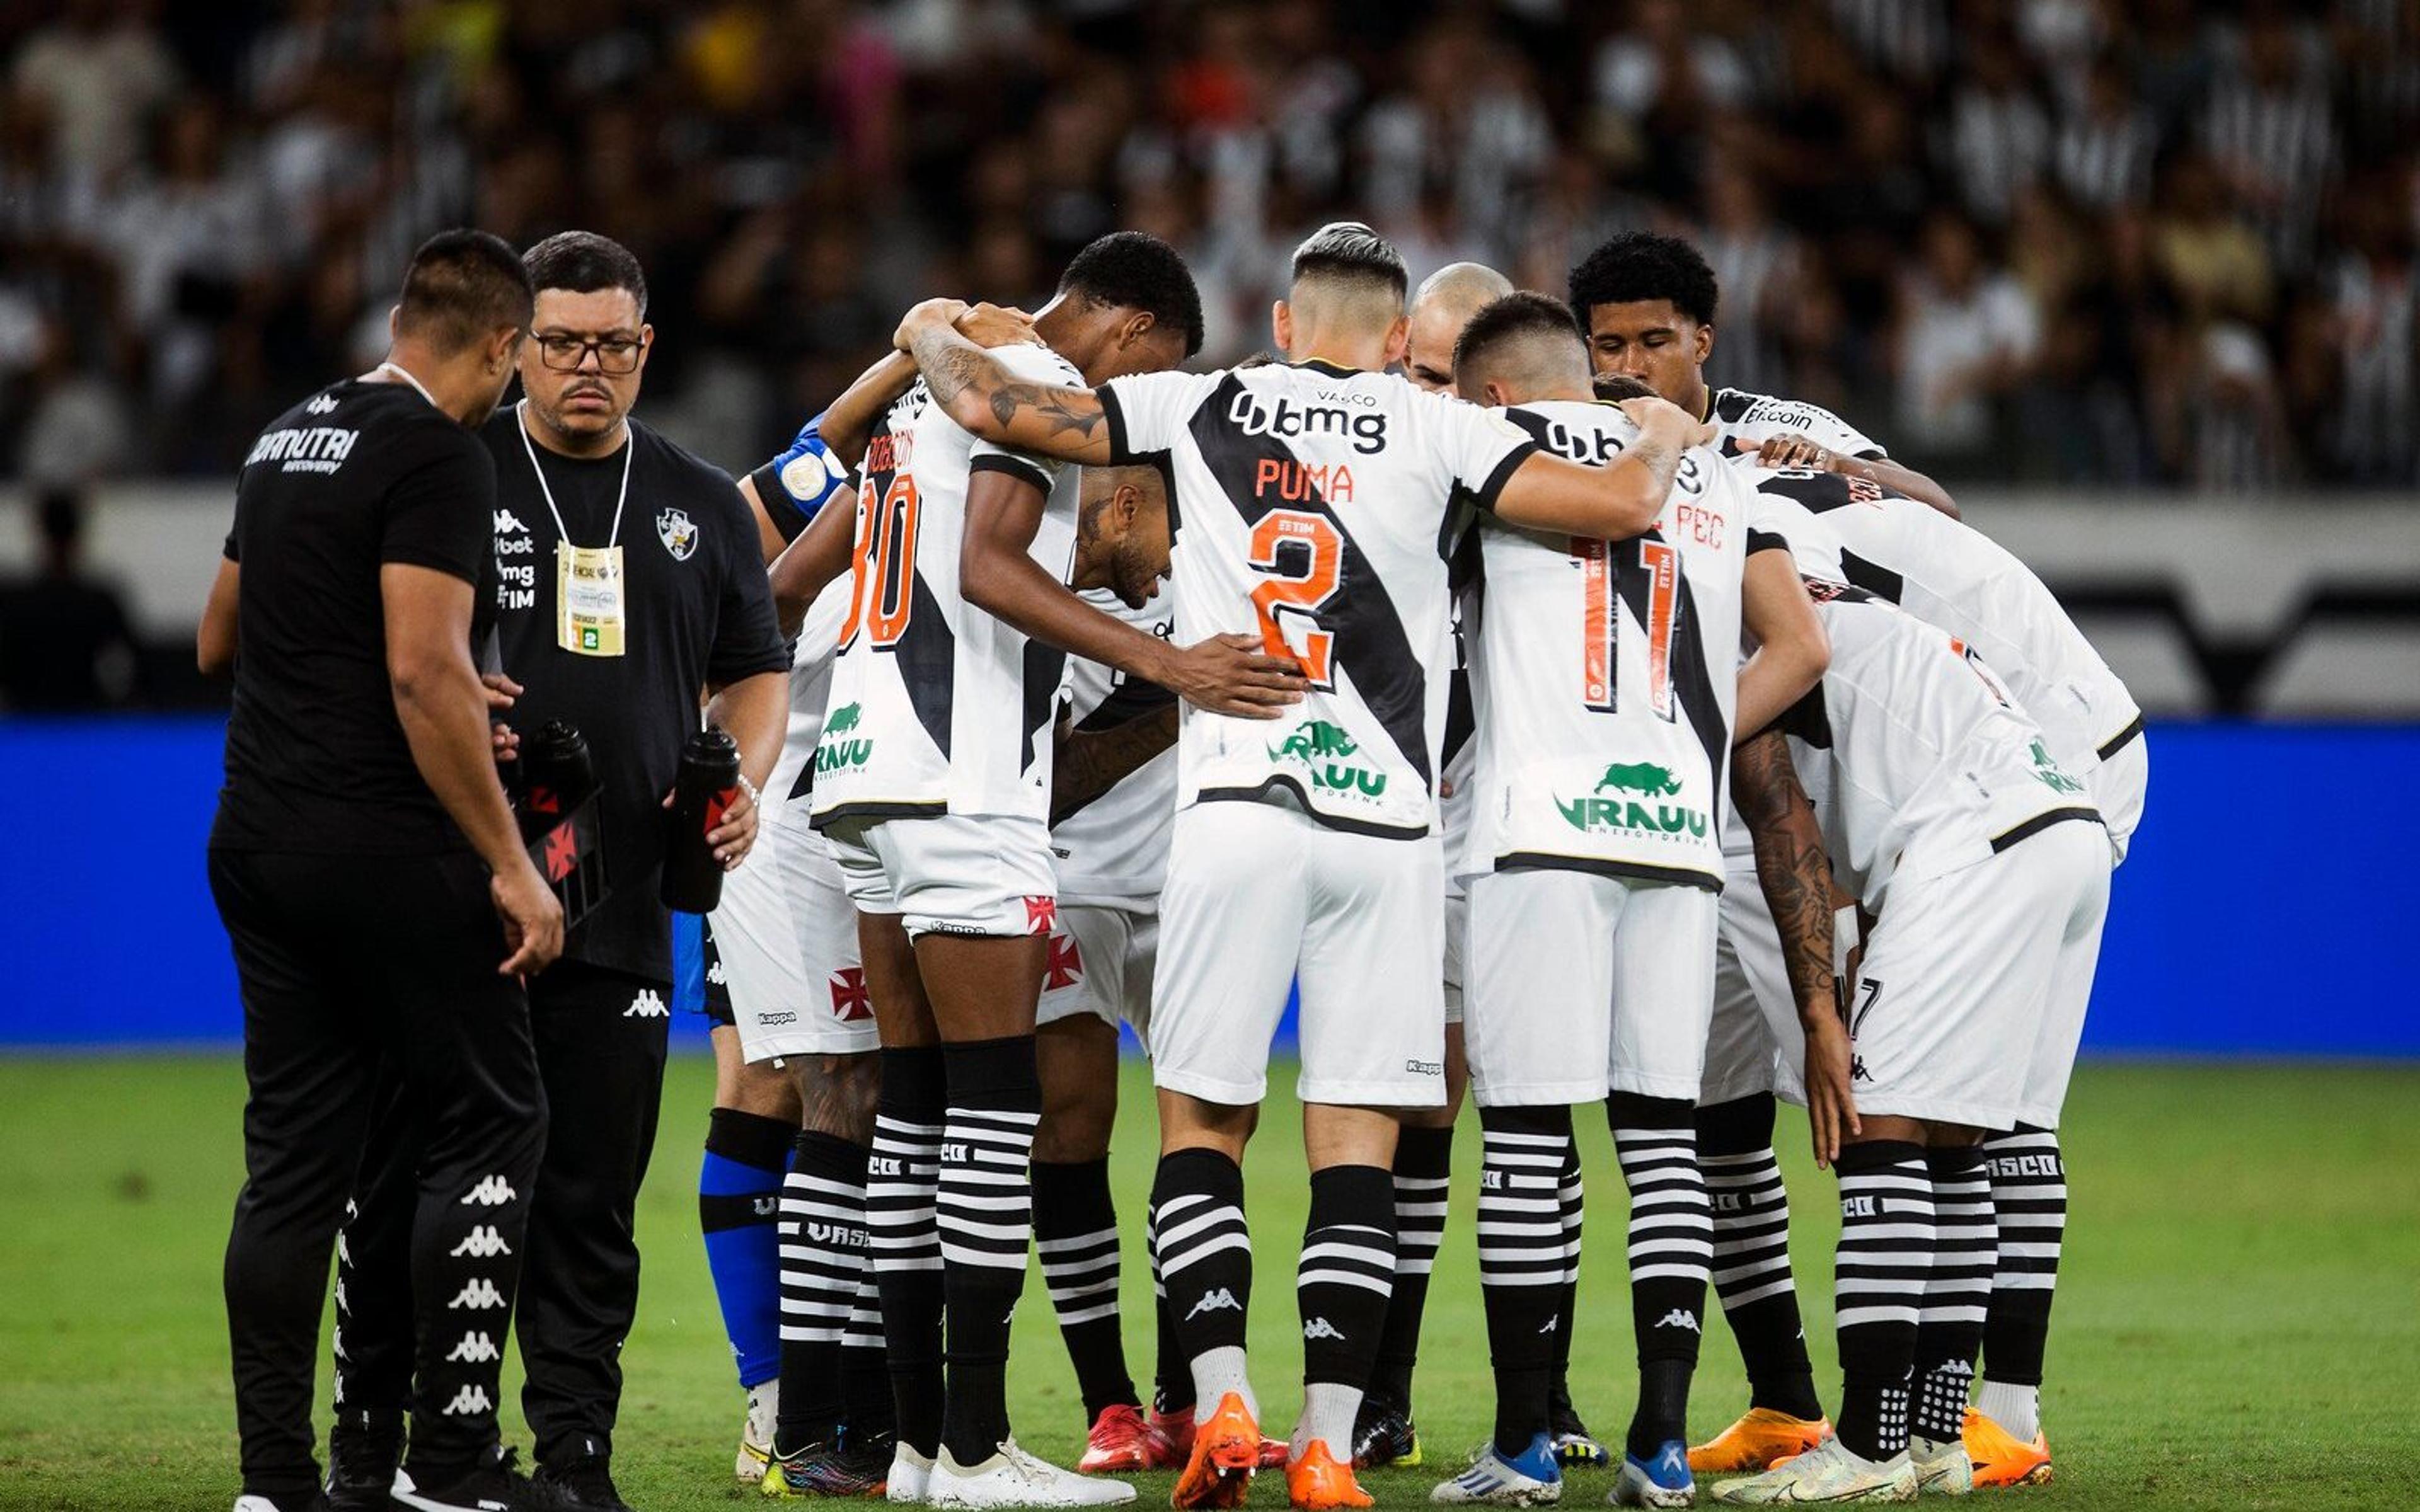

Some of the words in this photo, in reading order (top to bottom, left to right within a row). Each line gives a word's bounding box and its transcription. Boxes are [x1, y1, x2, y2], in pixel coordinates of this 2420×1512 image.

[1273, 398, 1387, 454] bmg
[1256, 458, 1355, 503] PUMA
[494, 536, 534, 555] bet
[1676, 505, 1725, 549] PEC
[495, 556, 534, 587] mg
[1247, 507, 1337, 694] 2
[1569, 537, 1681, 723] 11
[758, 1011, 797, 1026] Kappa
[1851, 977, 1884, 1041] 7
